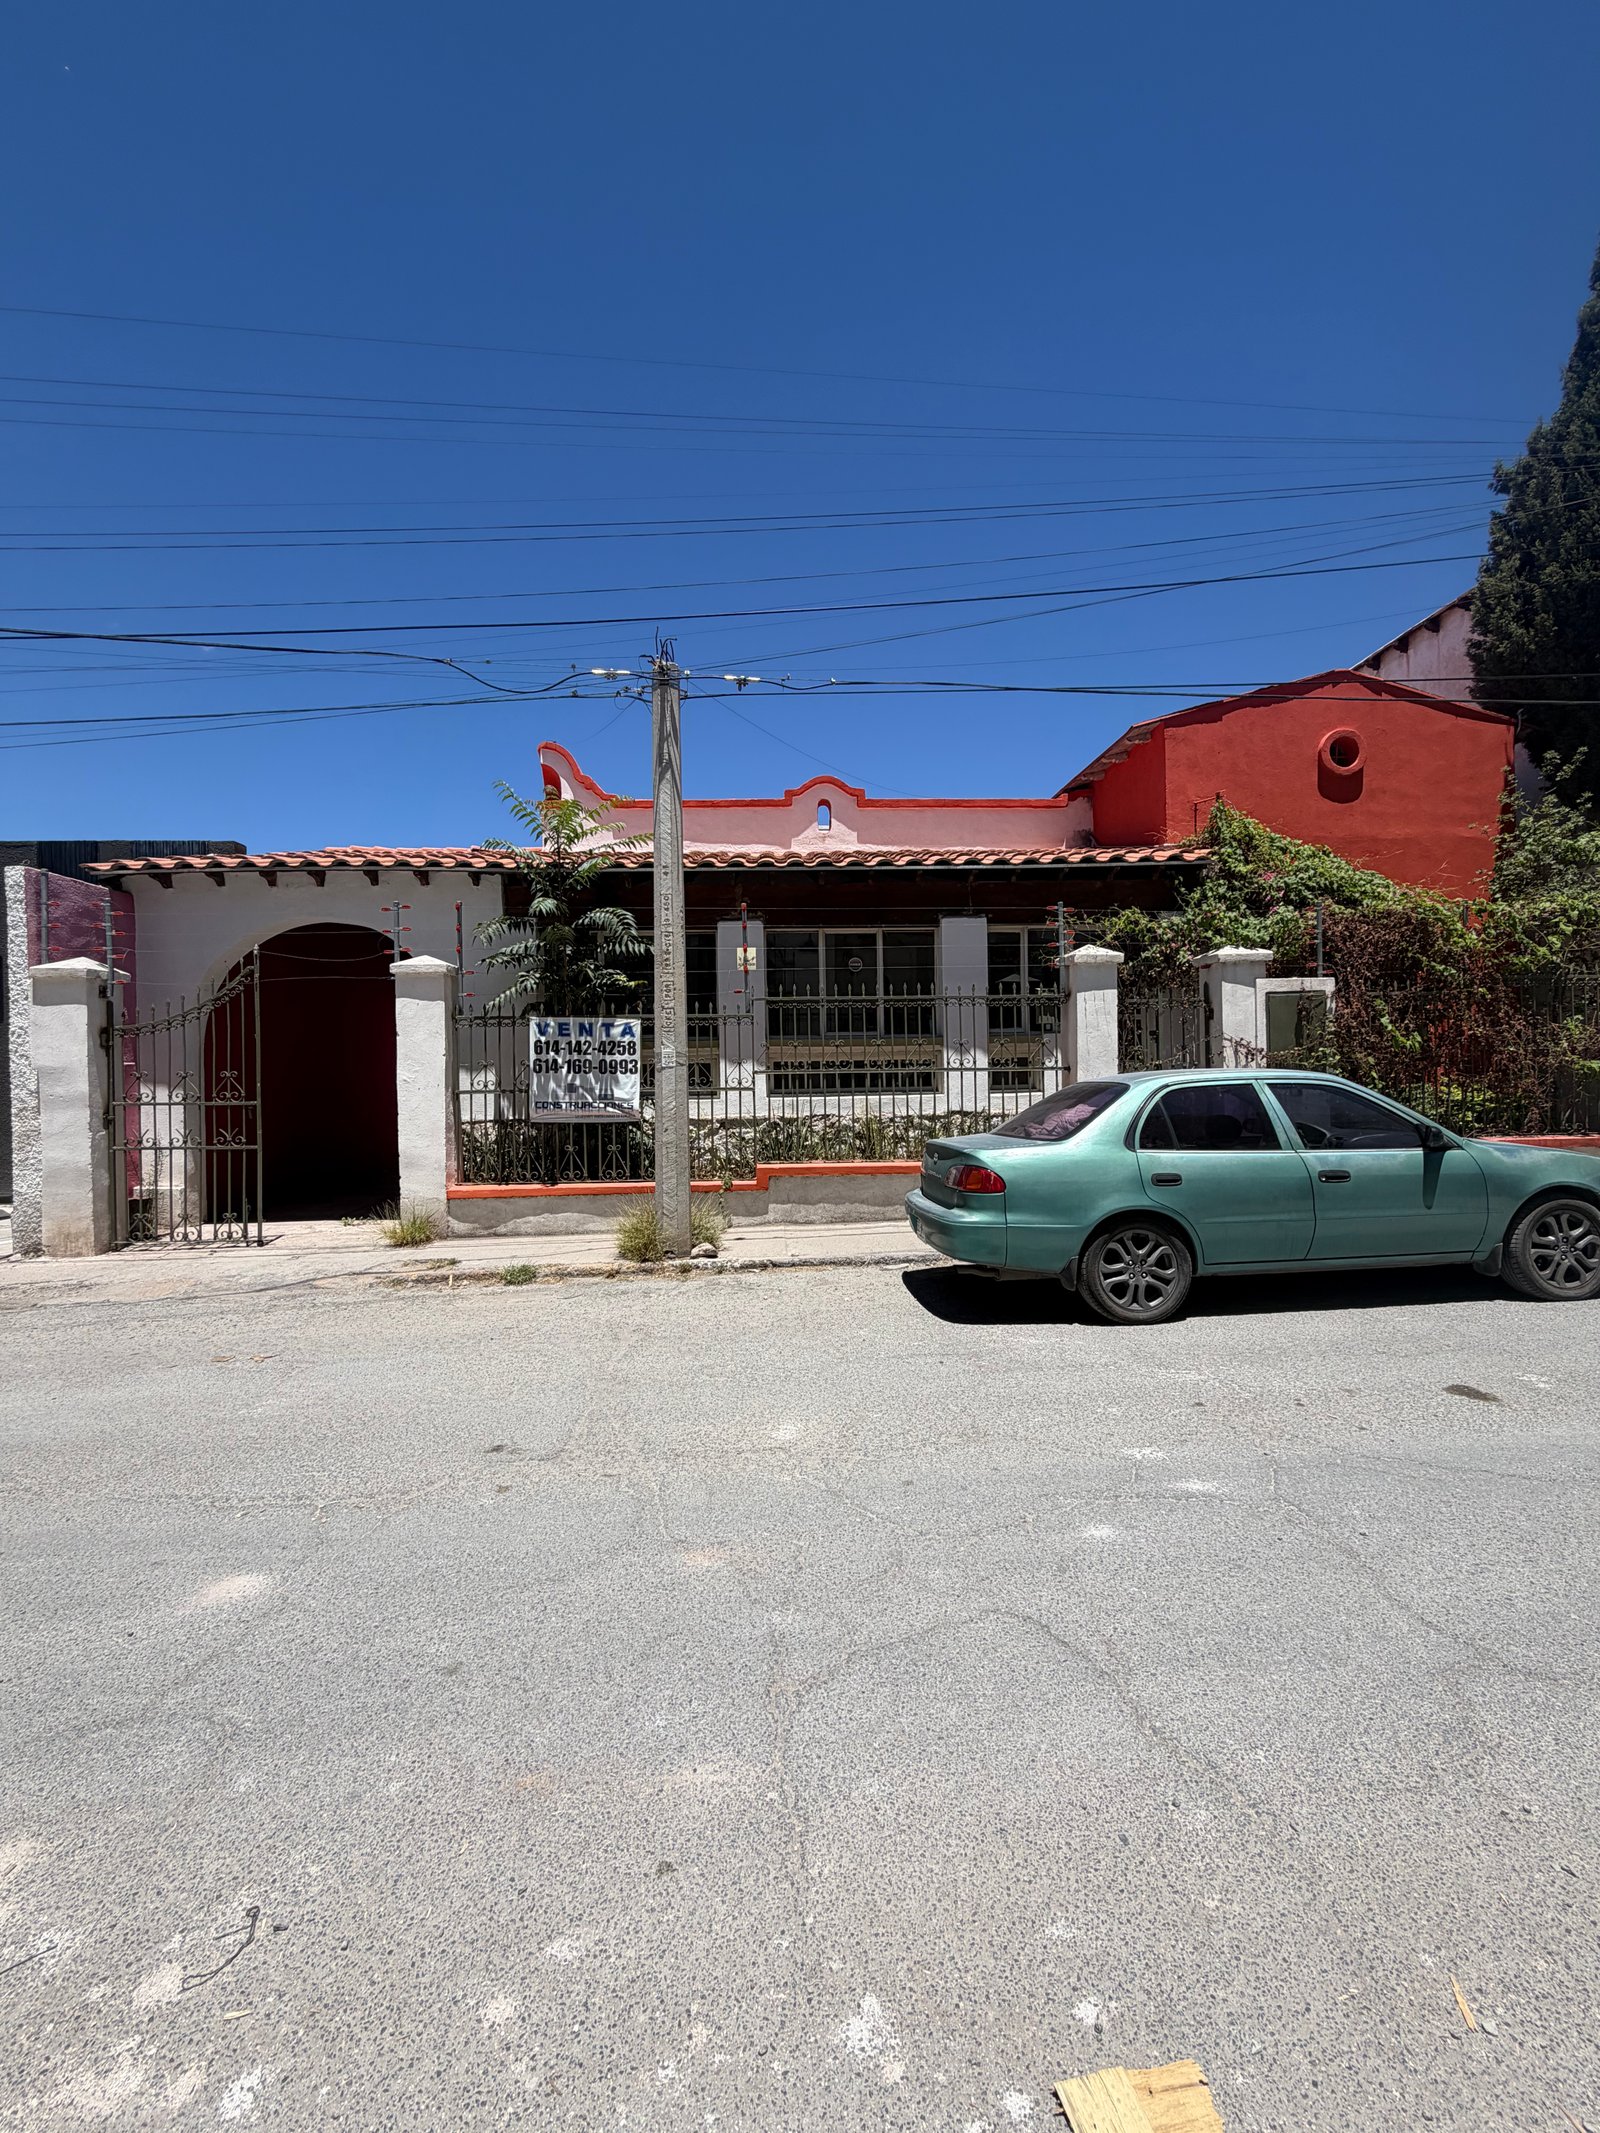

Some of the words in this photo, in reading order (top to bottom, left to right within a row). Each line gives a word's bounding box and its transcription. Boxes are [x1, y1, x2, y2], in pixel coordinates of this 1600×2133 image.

[535, 1022, 636, 1038] VENTA
[533, 1039, 637, 1056] 614-142-4258
[532, 1058, 638, 1075] 614-169-0993
